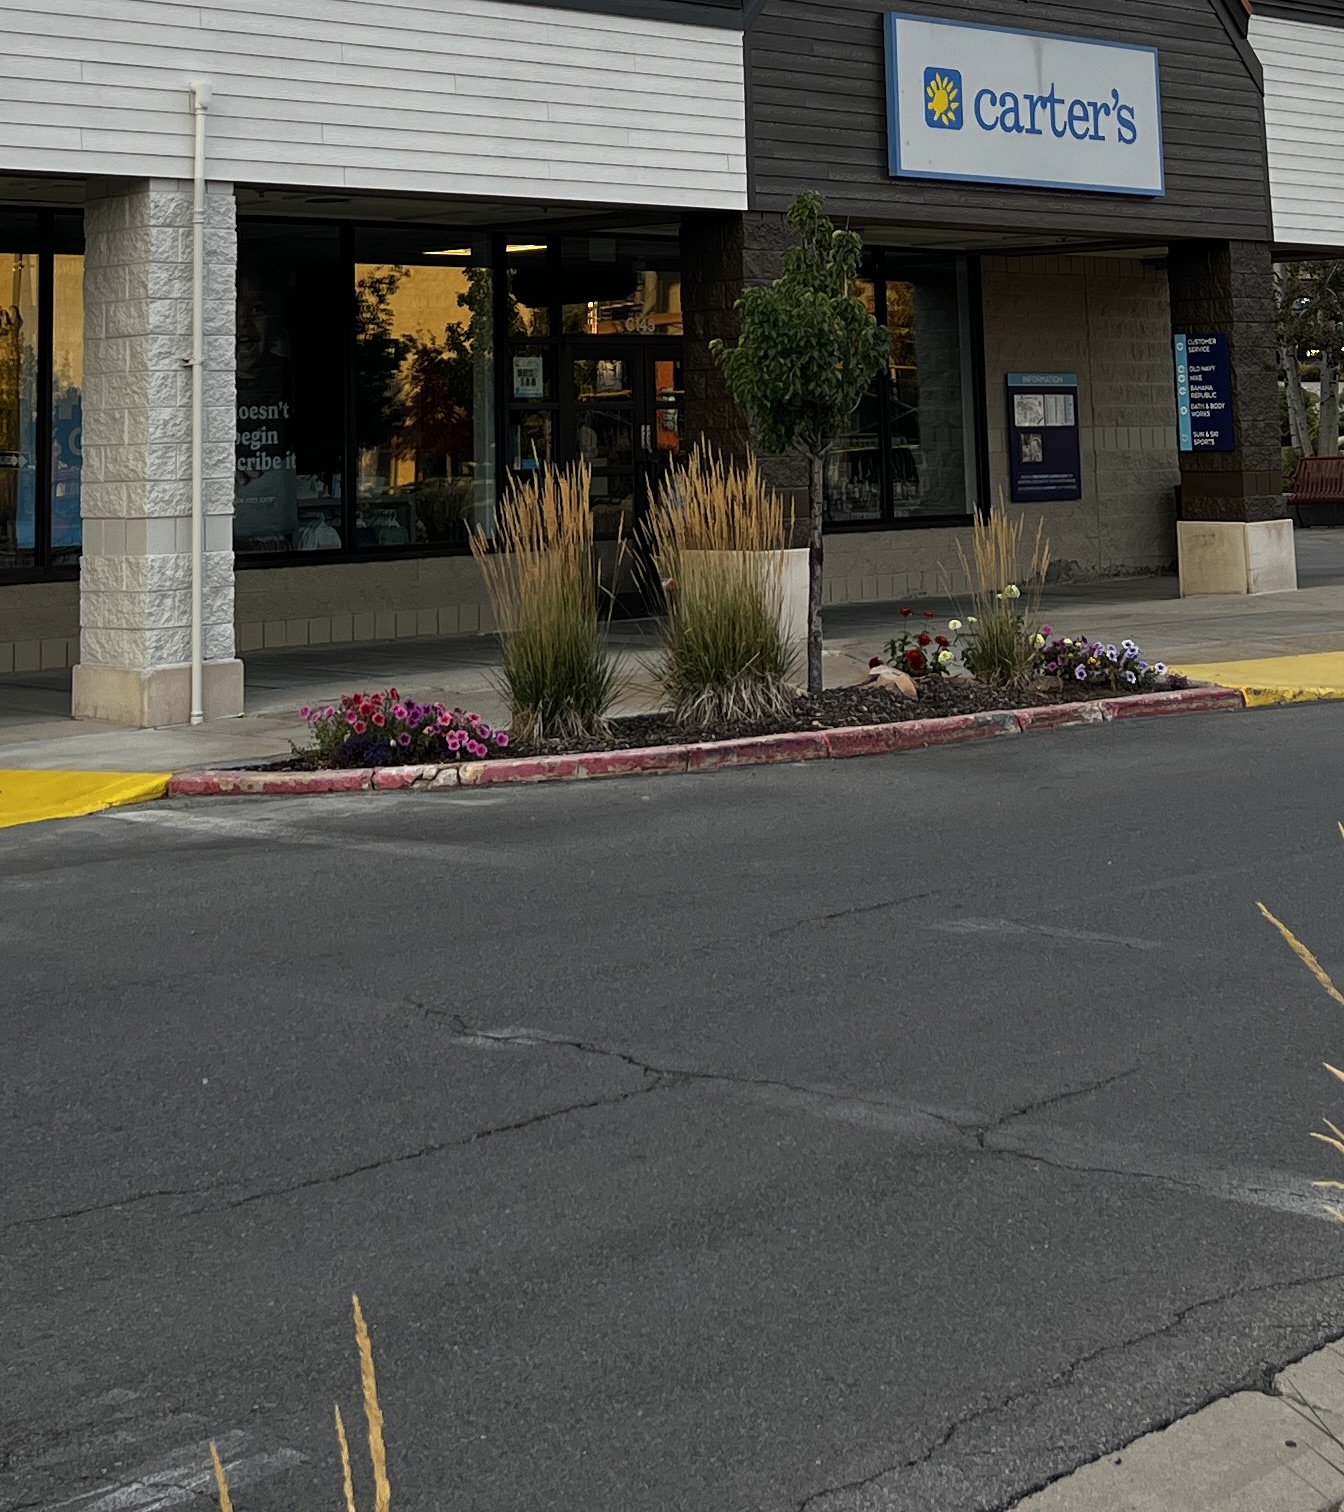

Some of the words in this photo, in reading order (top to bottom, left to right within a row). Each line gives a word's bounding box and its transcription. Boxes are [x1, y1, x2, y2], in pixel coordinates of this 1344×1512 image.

[974, 82, 1137, 145] carter's
[1022, 375, 1063, 383] INFORMATION
[236, 401, 289, 419] oesn't
[285, 450, 296, 469] it
